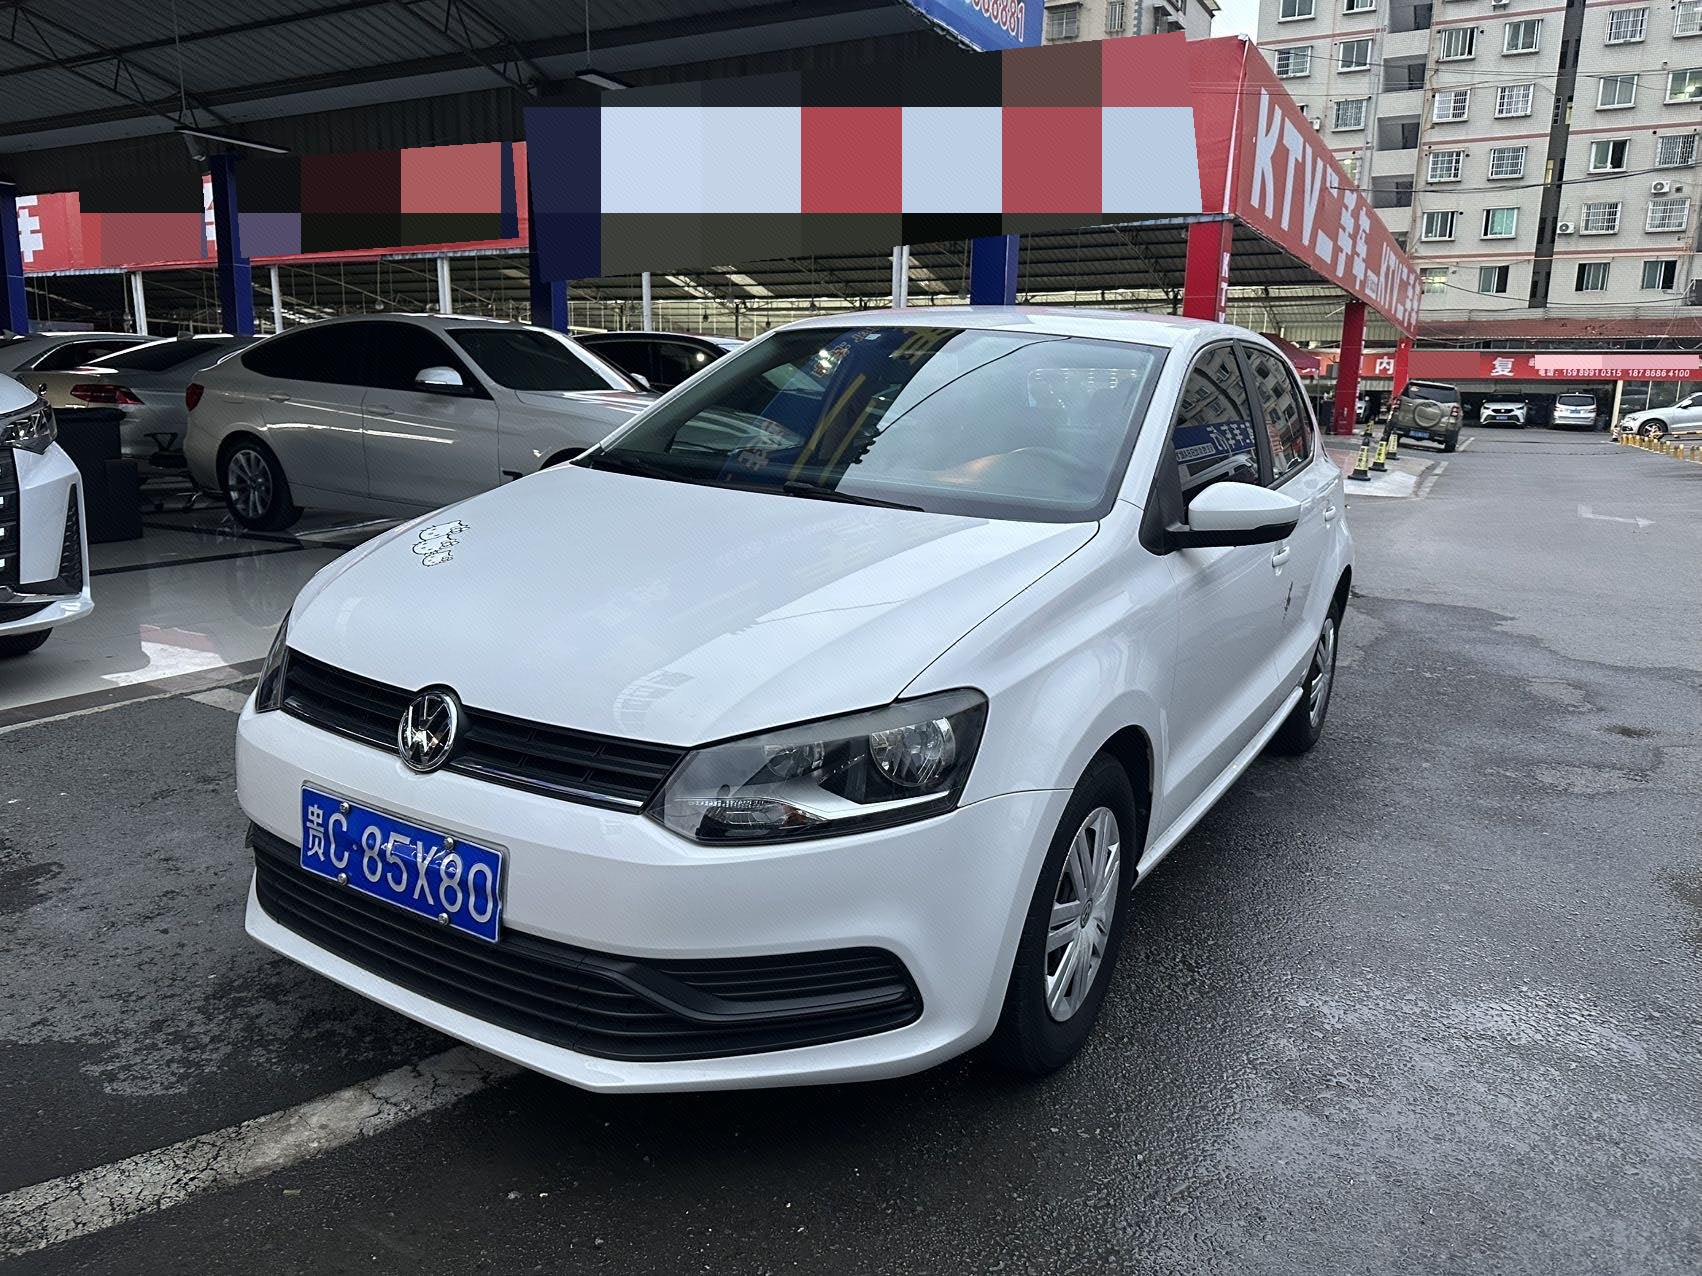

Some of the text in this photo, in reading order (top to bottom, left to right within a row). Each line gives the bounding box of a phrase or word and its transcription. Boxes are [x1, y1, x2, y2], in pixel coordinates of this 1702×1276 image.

[971, 0, 1025, 43] 8881
[1250, 87, 1371, 290] KTV二手车
[1374, 355, 1394, 375] 内
[1490, 357, 1515, 376] 复
